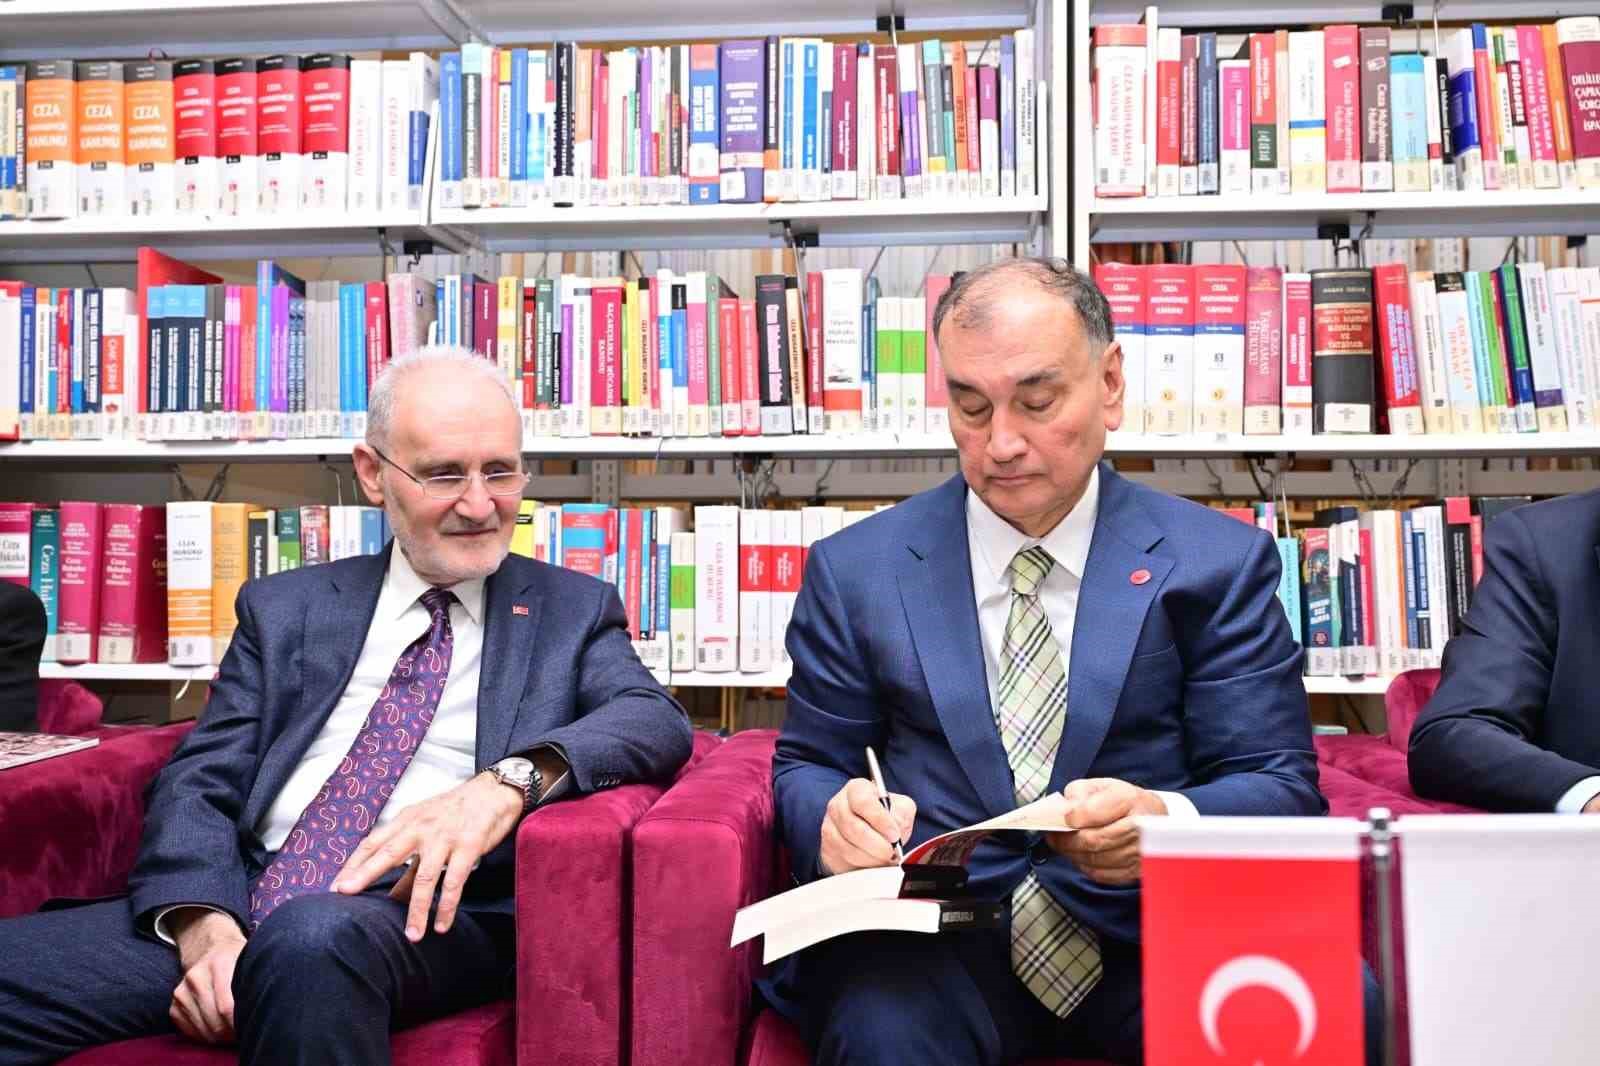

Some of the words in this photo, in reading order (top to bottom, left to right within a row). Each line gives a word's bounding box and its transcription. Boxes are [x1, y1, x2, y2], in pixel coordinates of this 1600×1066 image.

[1511, 63, 1525, 122] MÜSADERE
[32, 104, 61, 118] CEZA
[85, 105, 113, 119] CEZA
[132, 106, 161, 120] CEZA
[1536, 68, 1553, 149] TUTUKLAMA
[41, 544, 56, 575] Ceza
